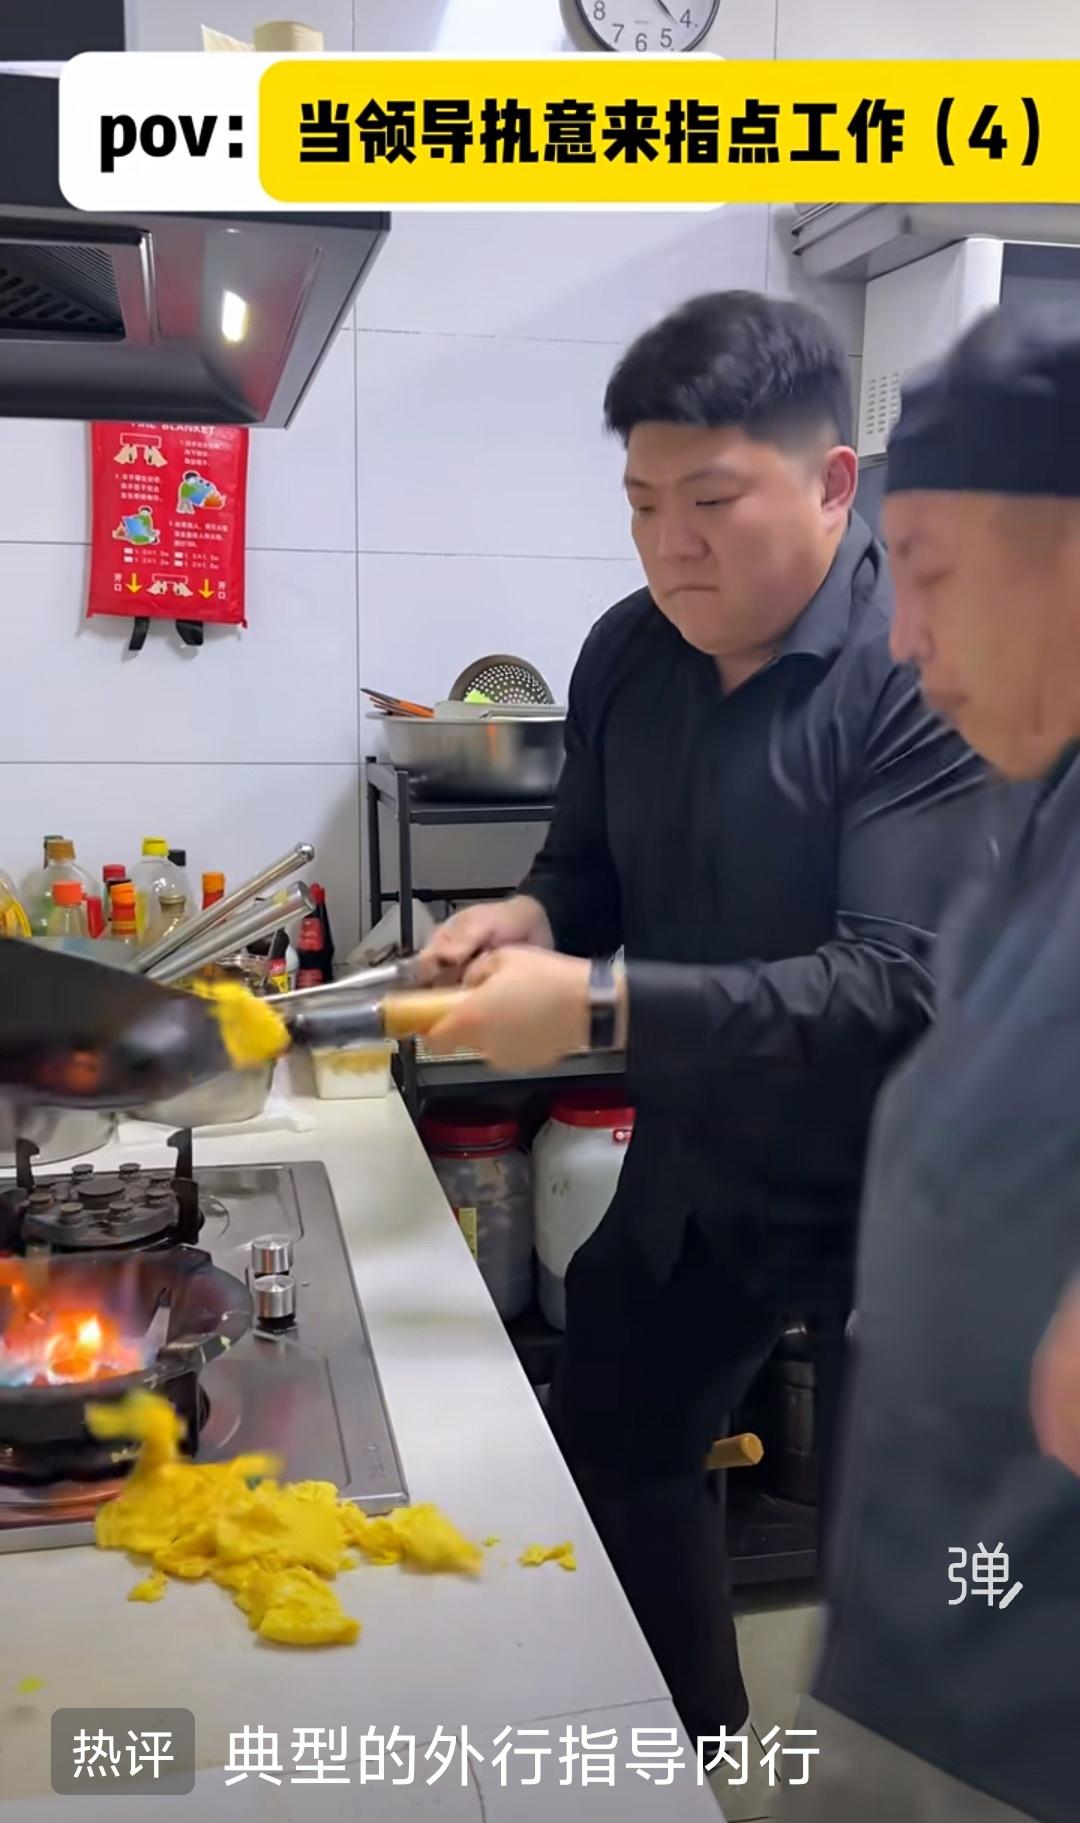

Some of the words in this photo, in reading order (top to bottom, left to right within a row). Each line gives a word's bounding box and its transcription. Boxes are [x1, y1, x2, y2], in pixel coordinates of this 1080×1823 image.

[593, 0, 606, 21] 8
[679, 9, 692, 29] 4
[612, 23, 625, 43] 7
[635, 32, 648, 51] 6
[660, 28, 673, 48] 5
